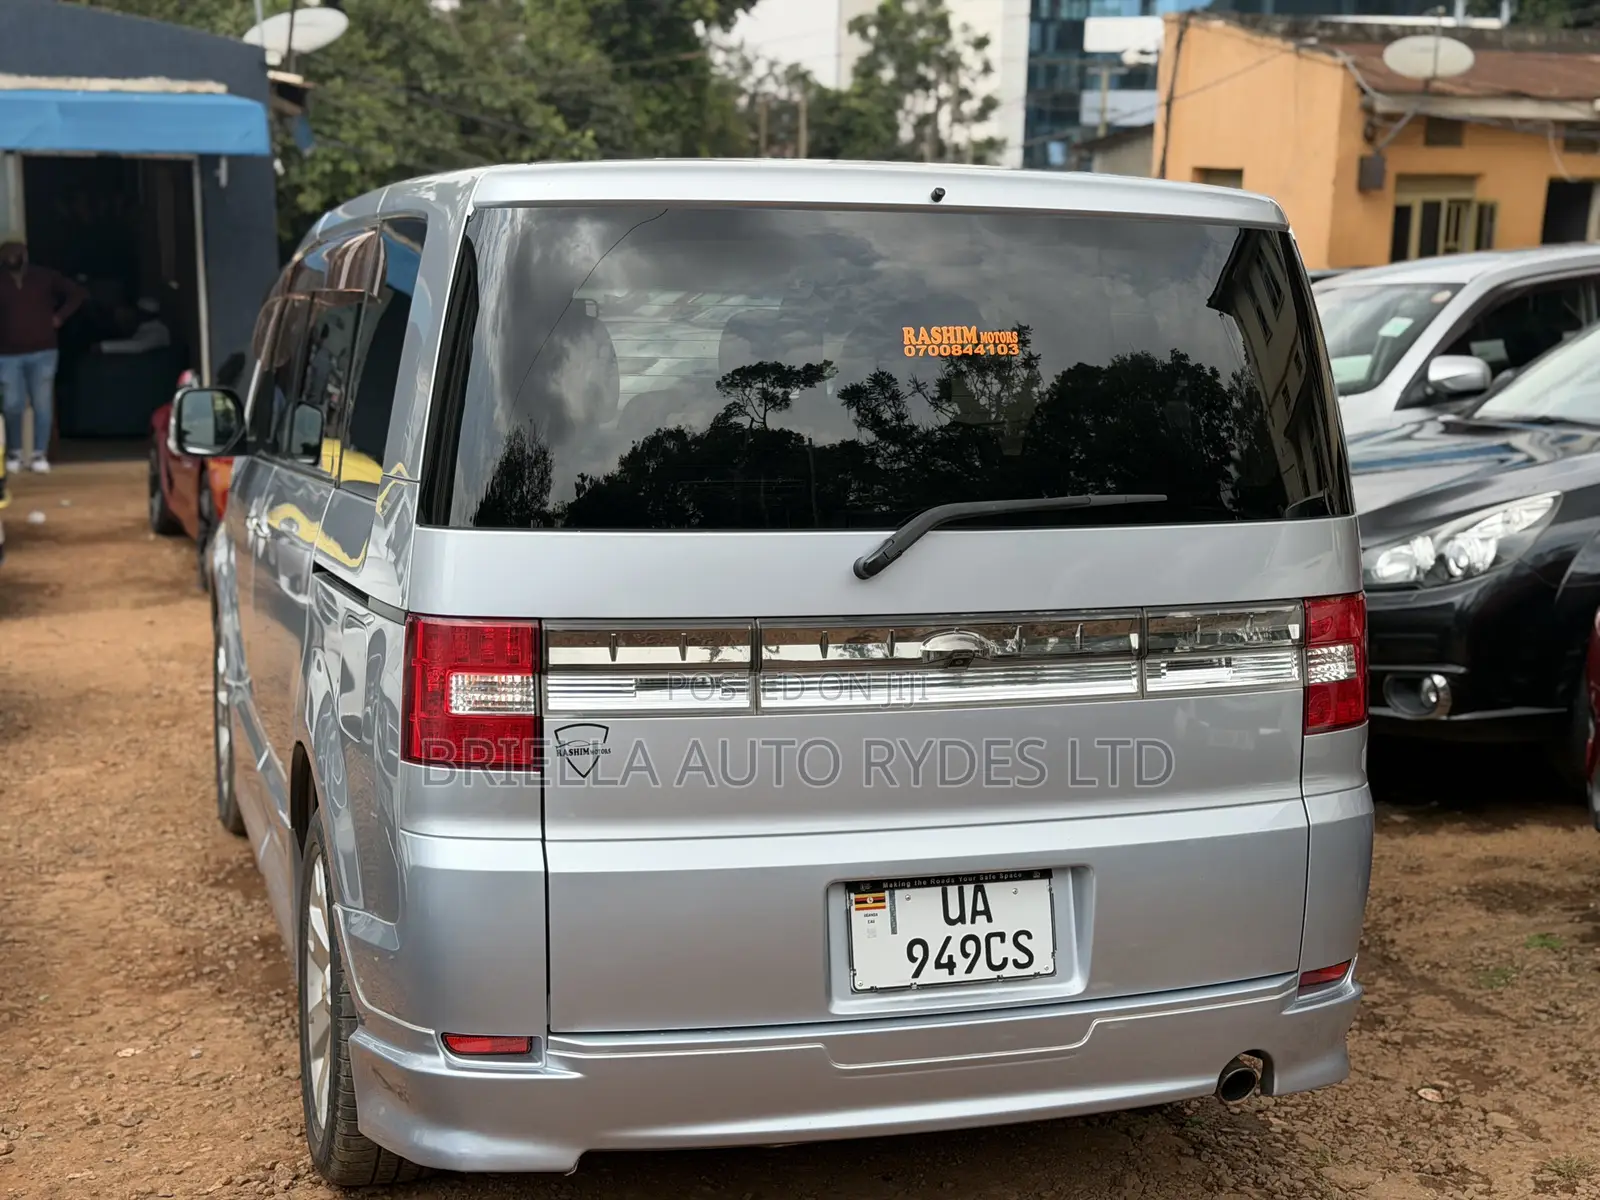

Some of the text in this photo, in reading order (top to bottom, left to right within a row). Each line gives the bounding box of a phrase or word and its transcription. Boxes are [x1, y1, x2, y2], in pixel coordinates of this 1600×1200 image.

[902, 326, 1019, 344] RASHIM MOTORS
[904, 344, 1020, 357] 0700844103
[882, 872, 1022, 890] Making the Roads Your Safe Space
[941, 884, 993, 926] UA
[906, 929, 1035, 979] 949CS
